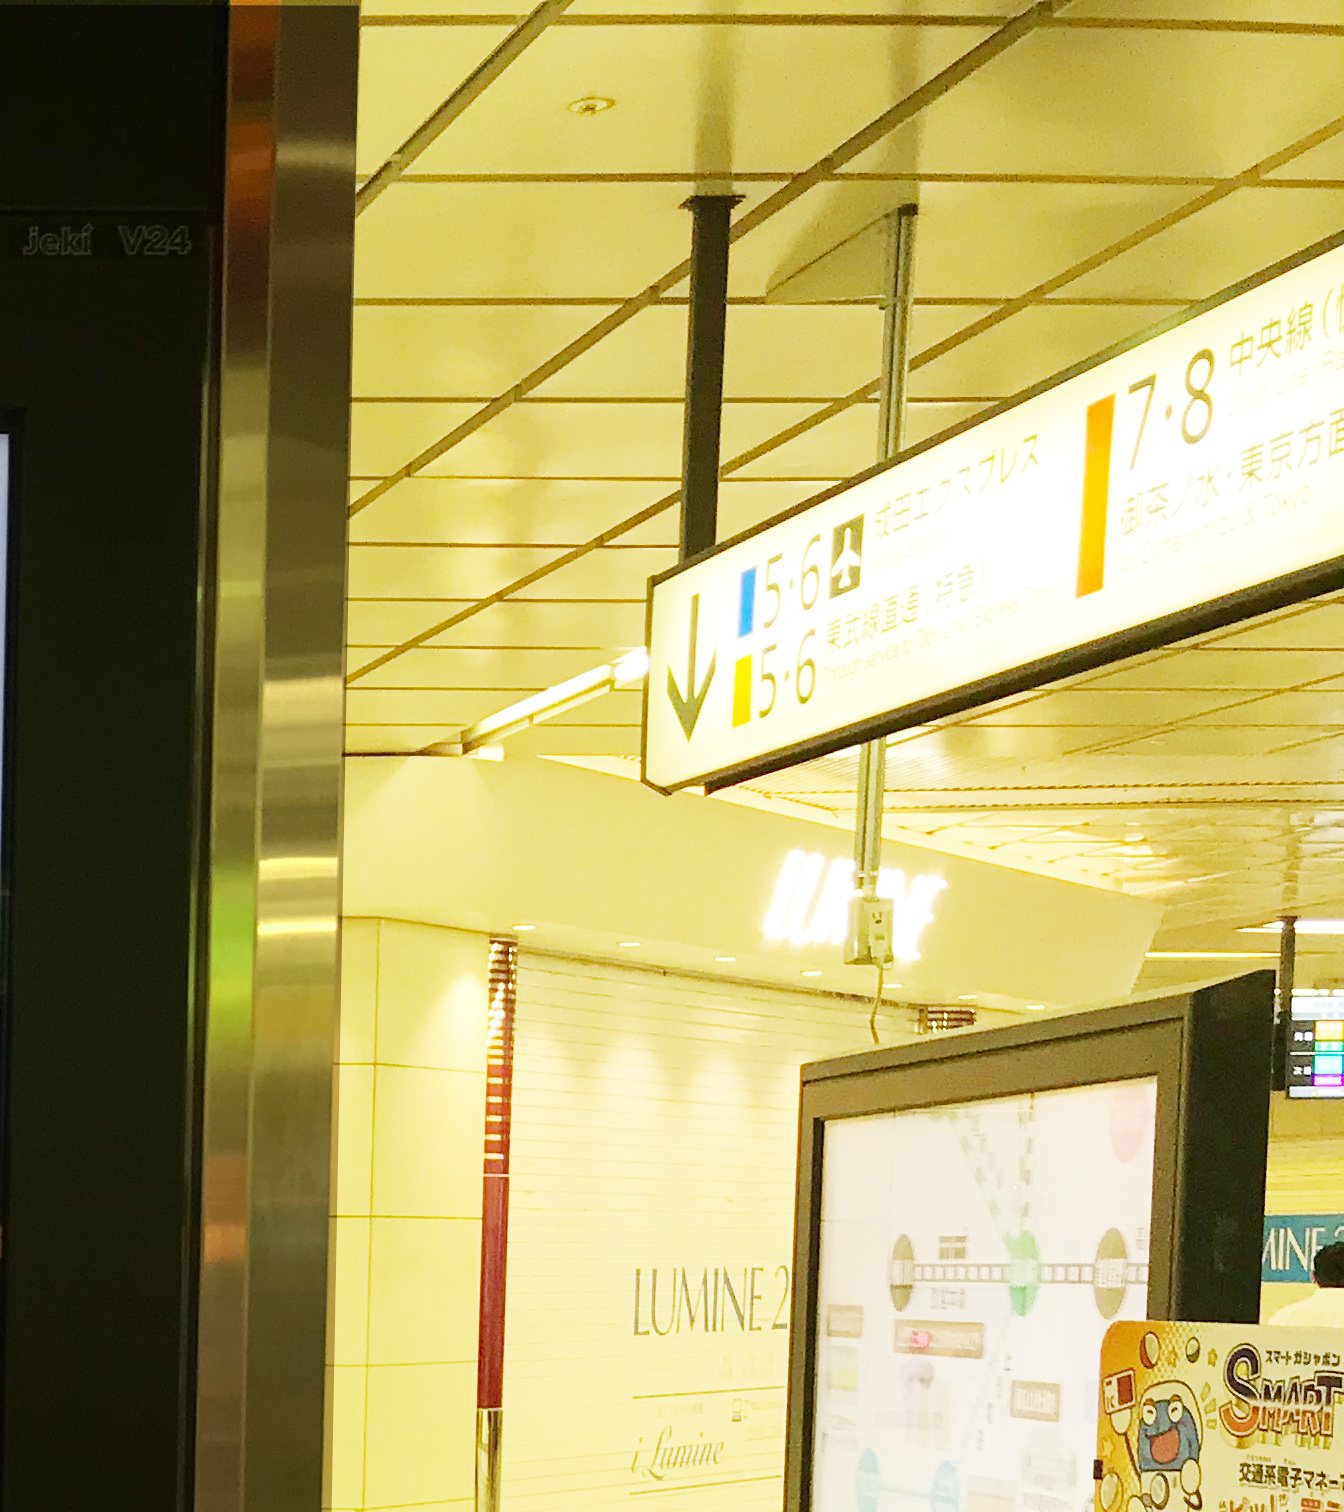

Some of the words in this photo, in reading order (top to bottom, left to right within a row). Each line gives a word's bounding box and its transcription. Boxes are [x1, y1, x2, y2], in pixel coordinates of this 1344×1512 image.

[23, 223, 95, 256] jeki
[117, 224, 192, 256] V24
[872, 432, 1040, 541] 成田エクスプレス
[1140, 513, 1241, 566] Ochanomizu
[863, 642, 900, 673] service
[633, 1265, 764, 1336] LUMINE
[770, 1264, 790, 1330] 2
[1265, 1349, 1341, 1367] スマートガシャポン
[1219, 1343, 1344, 1438] SMART
[642, 1425, 724, 1481] Lumine
